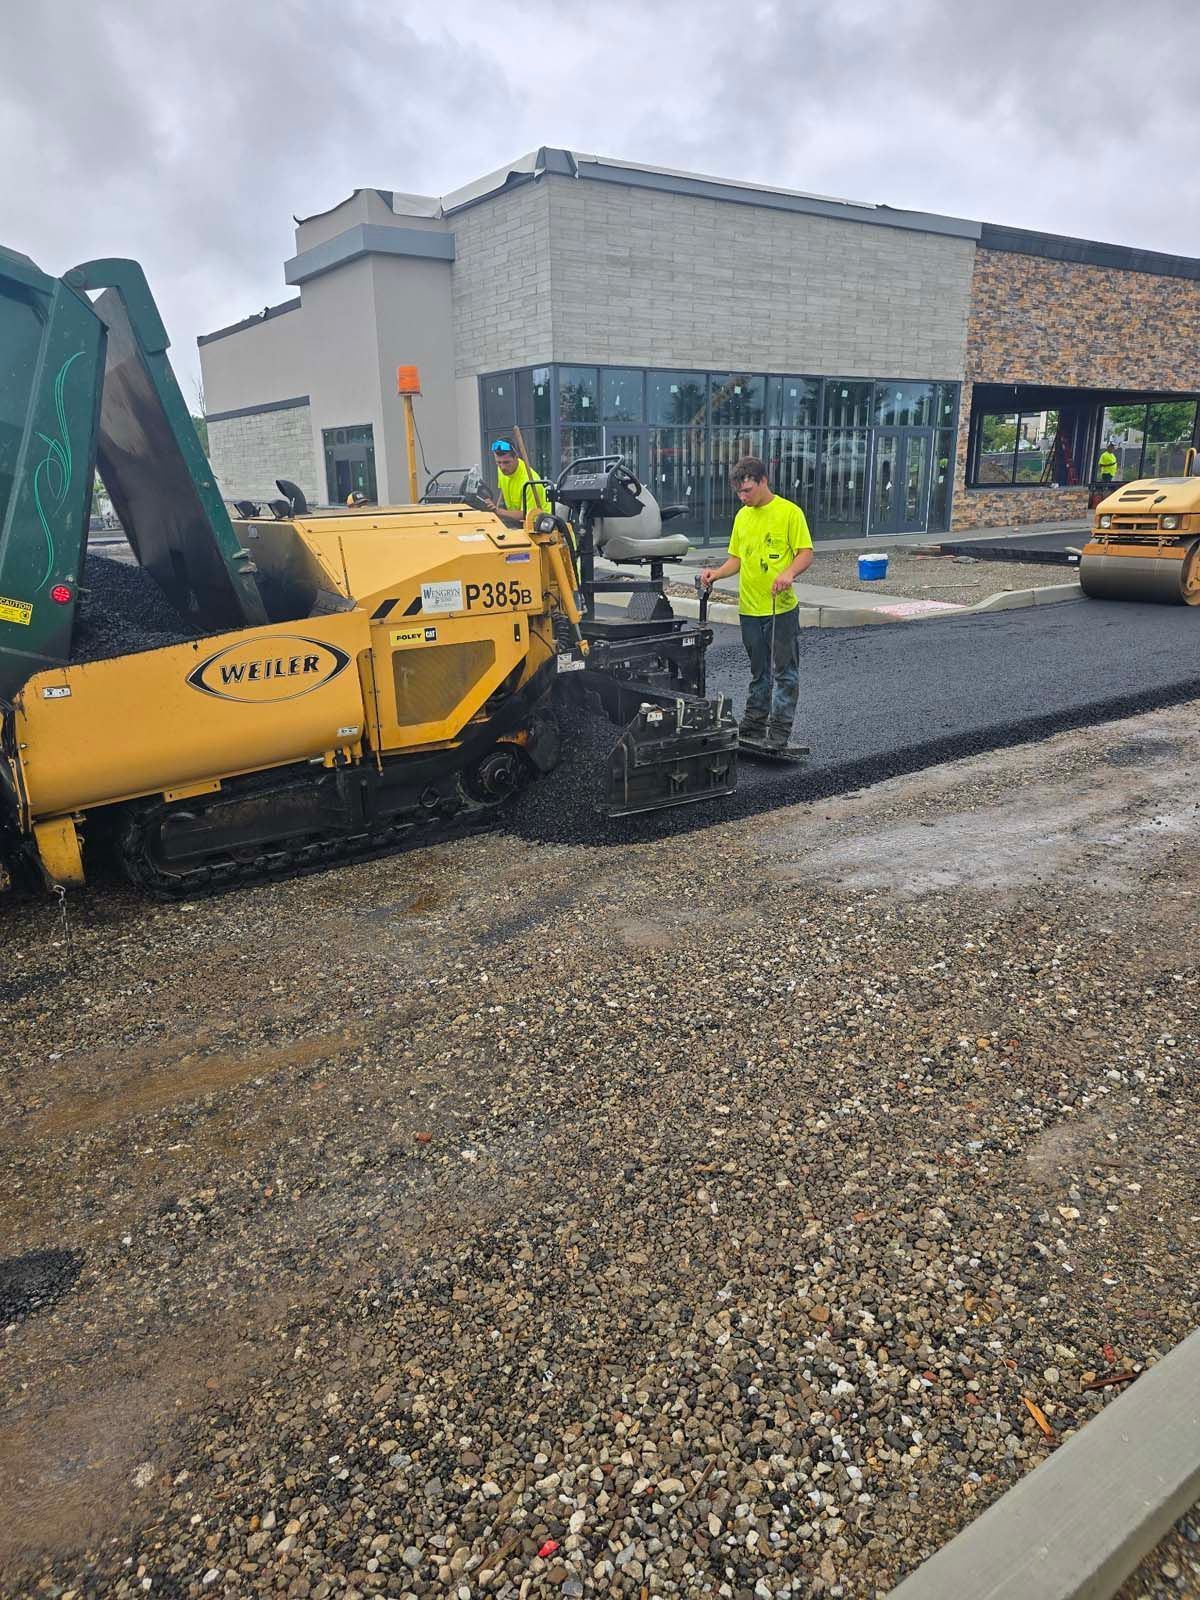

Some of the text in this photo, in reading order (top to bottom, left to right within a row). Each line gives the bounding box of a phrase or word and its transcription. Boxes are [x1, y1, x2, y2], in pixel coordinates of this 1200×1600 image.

[0, 599, 31, 611] CAUTION
[396, 633, 422, 641] FOLEY
[219, 654, 320, 685] WEILER
